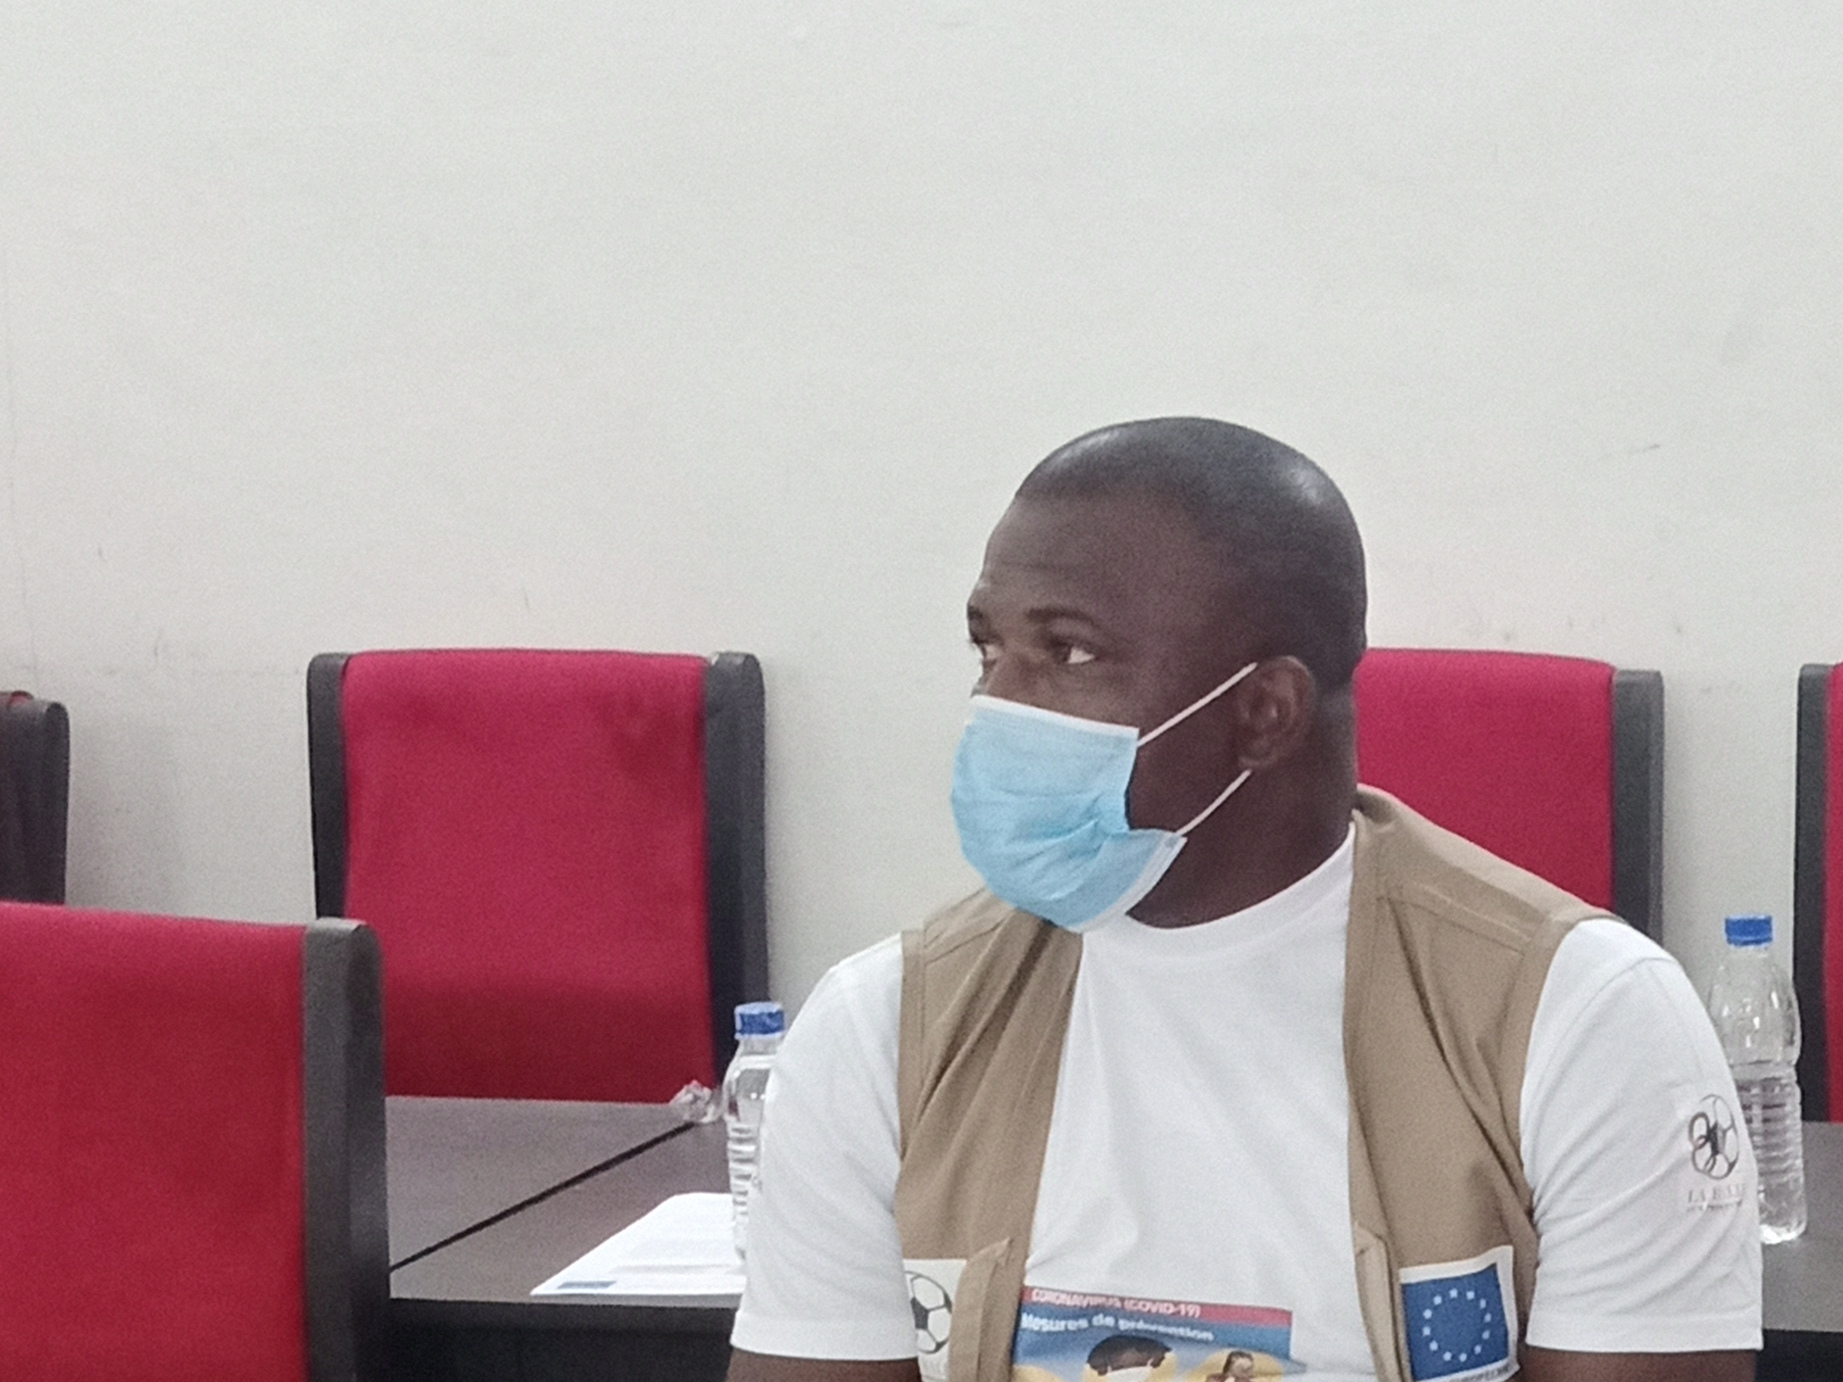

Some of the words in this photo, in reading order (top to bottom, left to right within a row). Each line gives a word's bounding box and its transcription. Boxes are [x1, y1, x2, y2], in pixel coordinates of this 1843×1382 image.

[1123, 1298, 1202, 1319] (COVID-19)
[1020, 1311, 1089, 1332] Mesures
[1091, 1312, 1116, 1328] de
